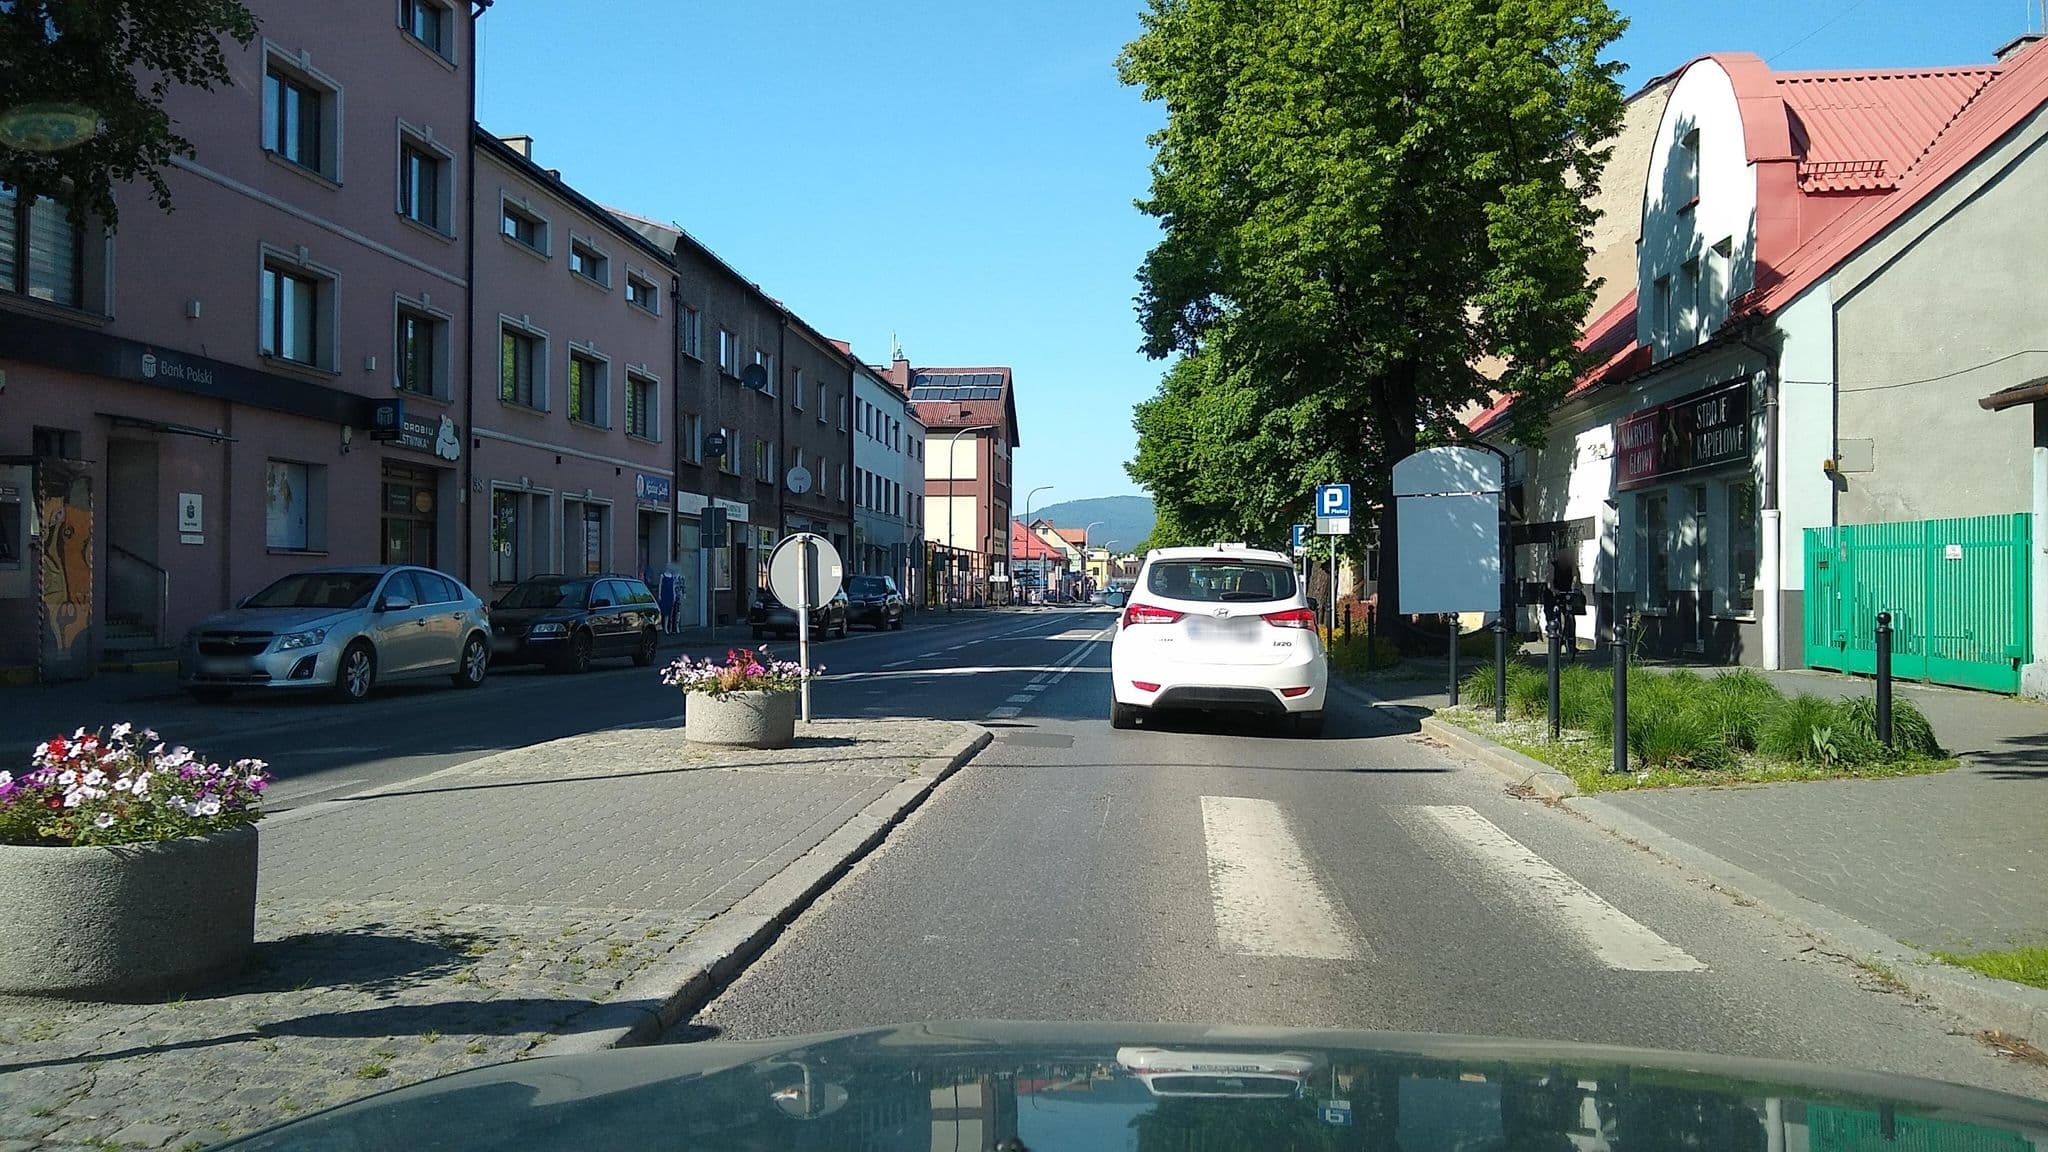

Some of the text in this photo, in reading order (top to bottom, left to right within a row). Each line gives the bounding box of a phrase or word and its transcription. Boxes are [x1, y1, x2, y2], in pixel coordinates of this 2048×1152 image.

[161, 360, 184, 379] Bank
[187, 366, 213, 385] Polski
[1696, 396, 1727, 430] STROJE
[1621, 420, 1654, 450] NAKRYCIA
[1323, 488, 1343, 514] P
